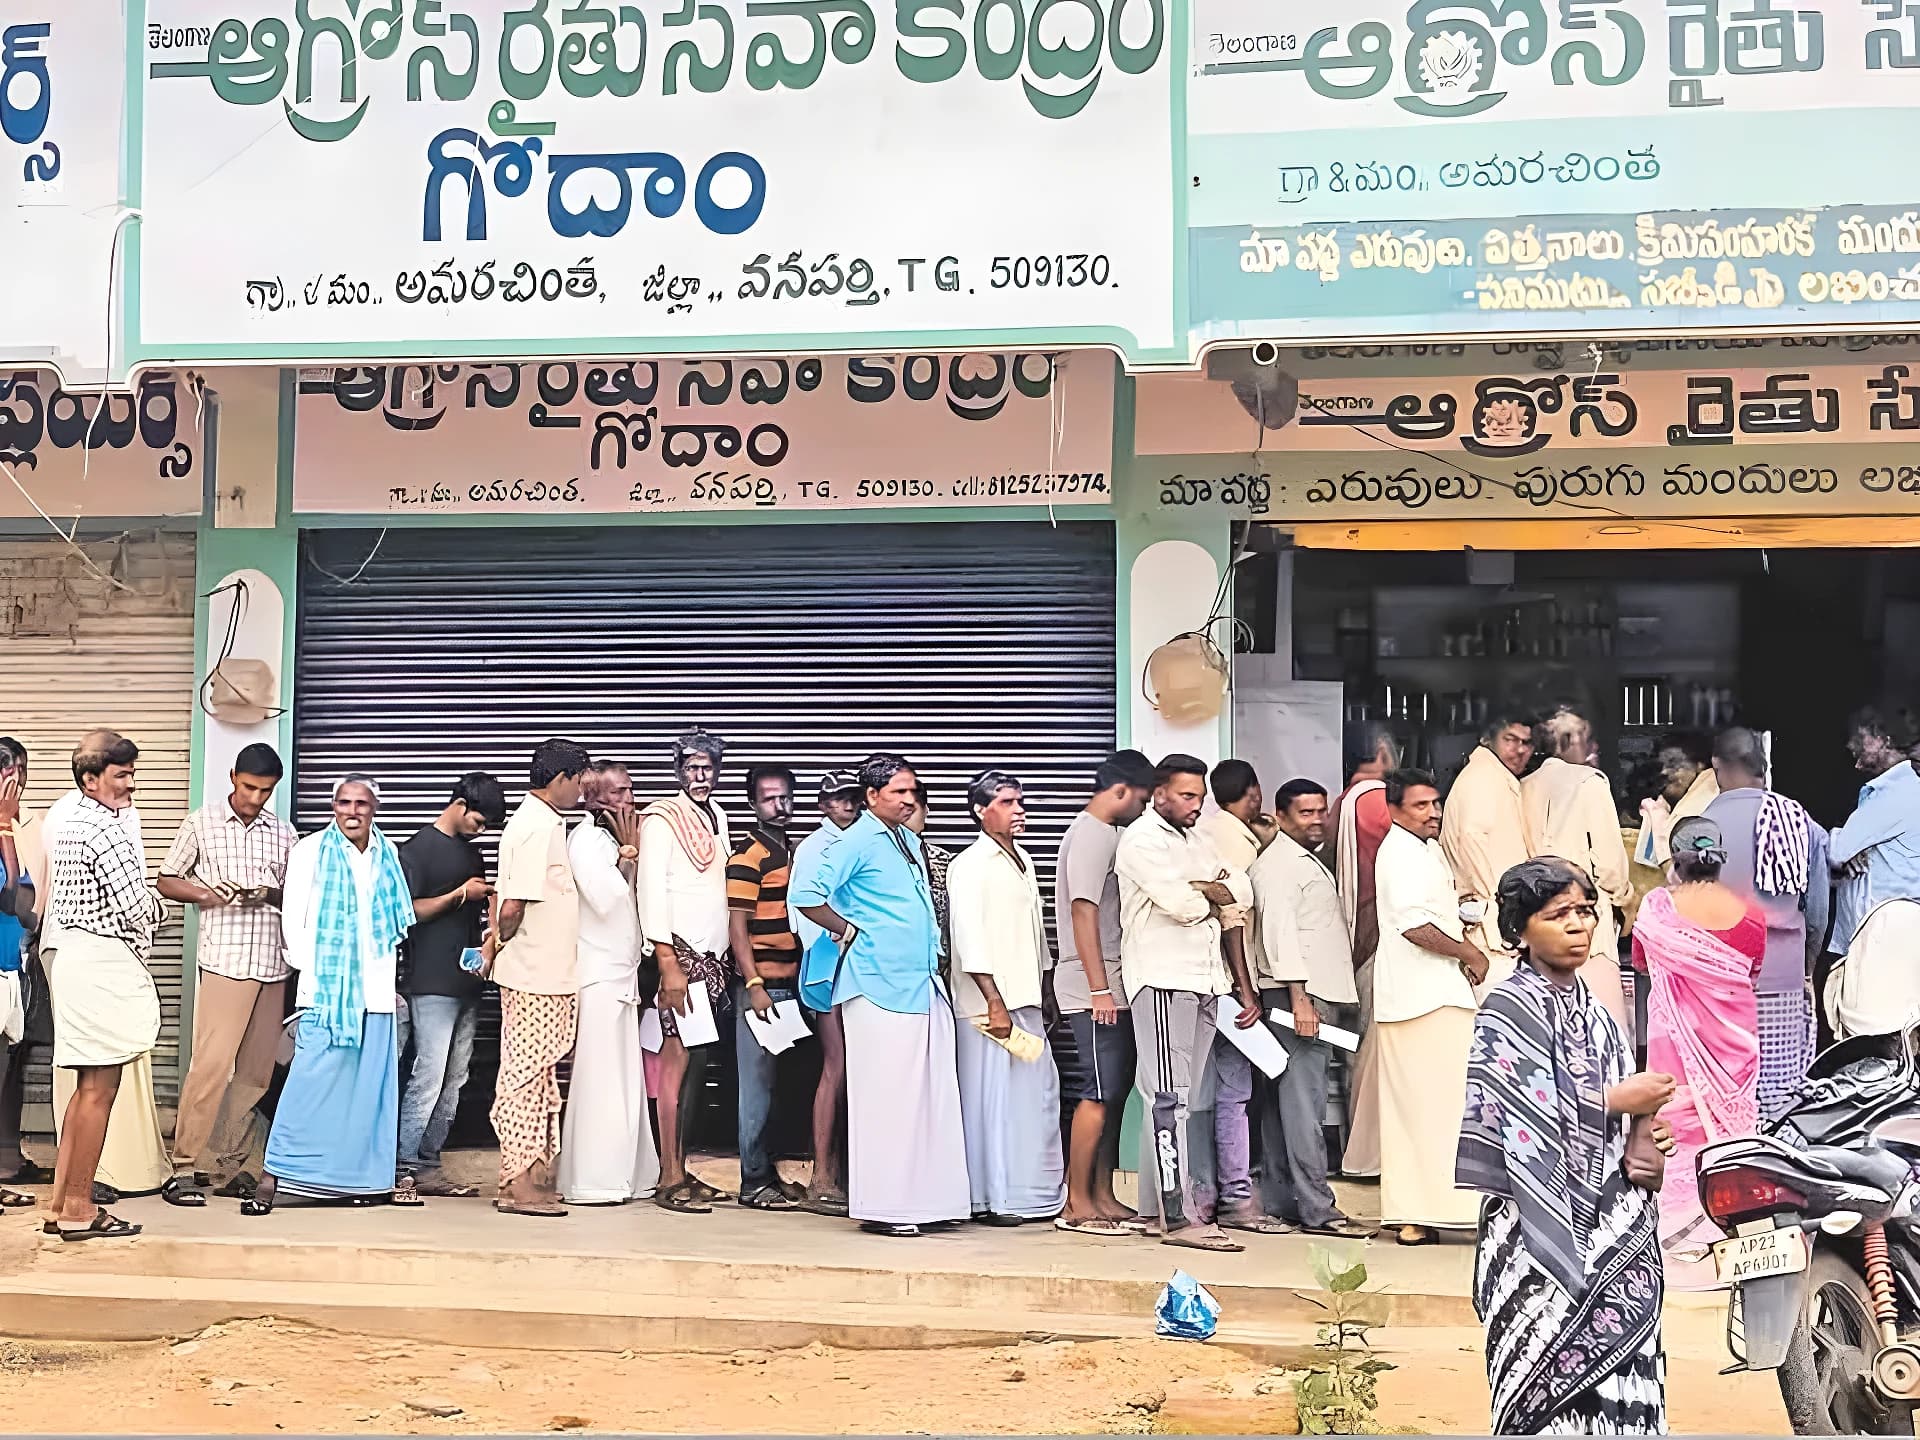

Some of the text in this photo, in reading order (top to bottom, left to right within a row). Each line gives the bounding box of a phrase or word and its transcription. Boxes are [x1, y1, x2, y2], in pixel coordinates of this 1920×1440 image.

[422, 127, 766, 242] గోదాం
[590, 407, 790, 469] గోదాం
[1667, 373, 1840, 446] రైతు
[1662, 463, 1838, 495] మందులు
